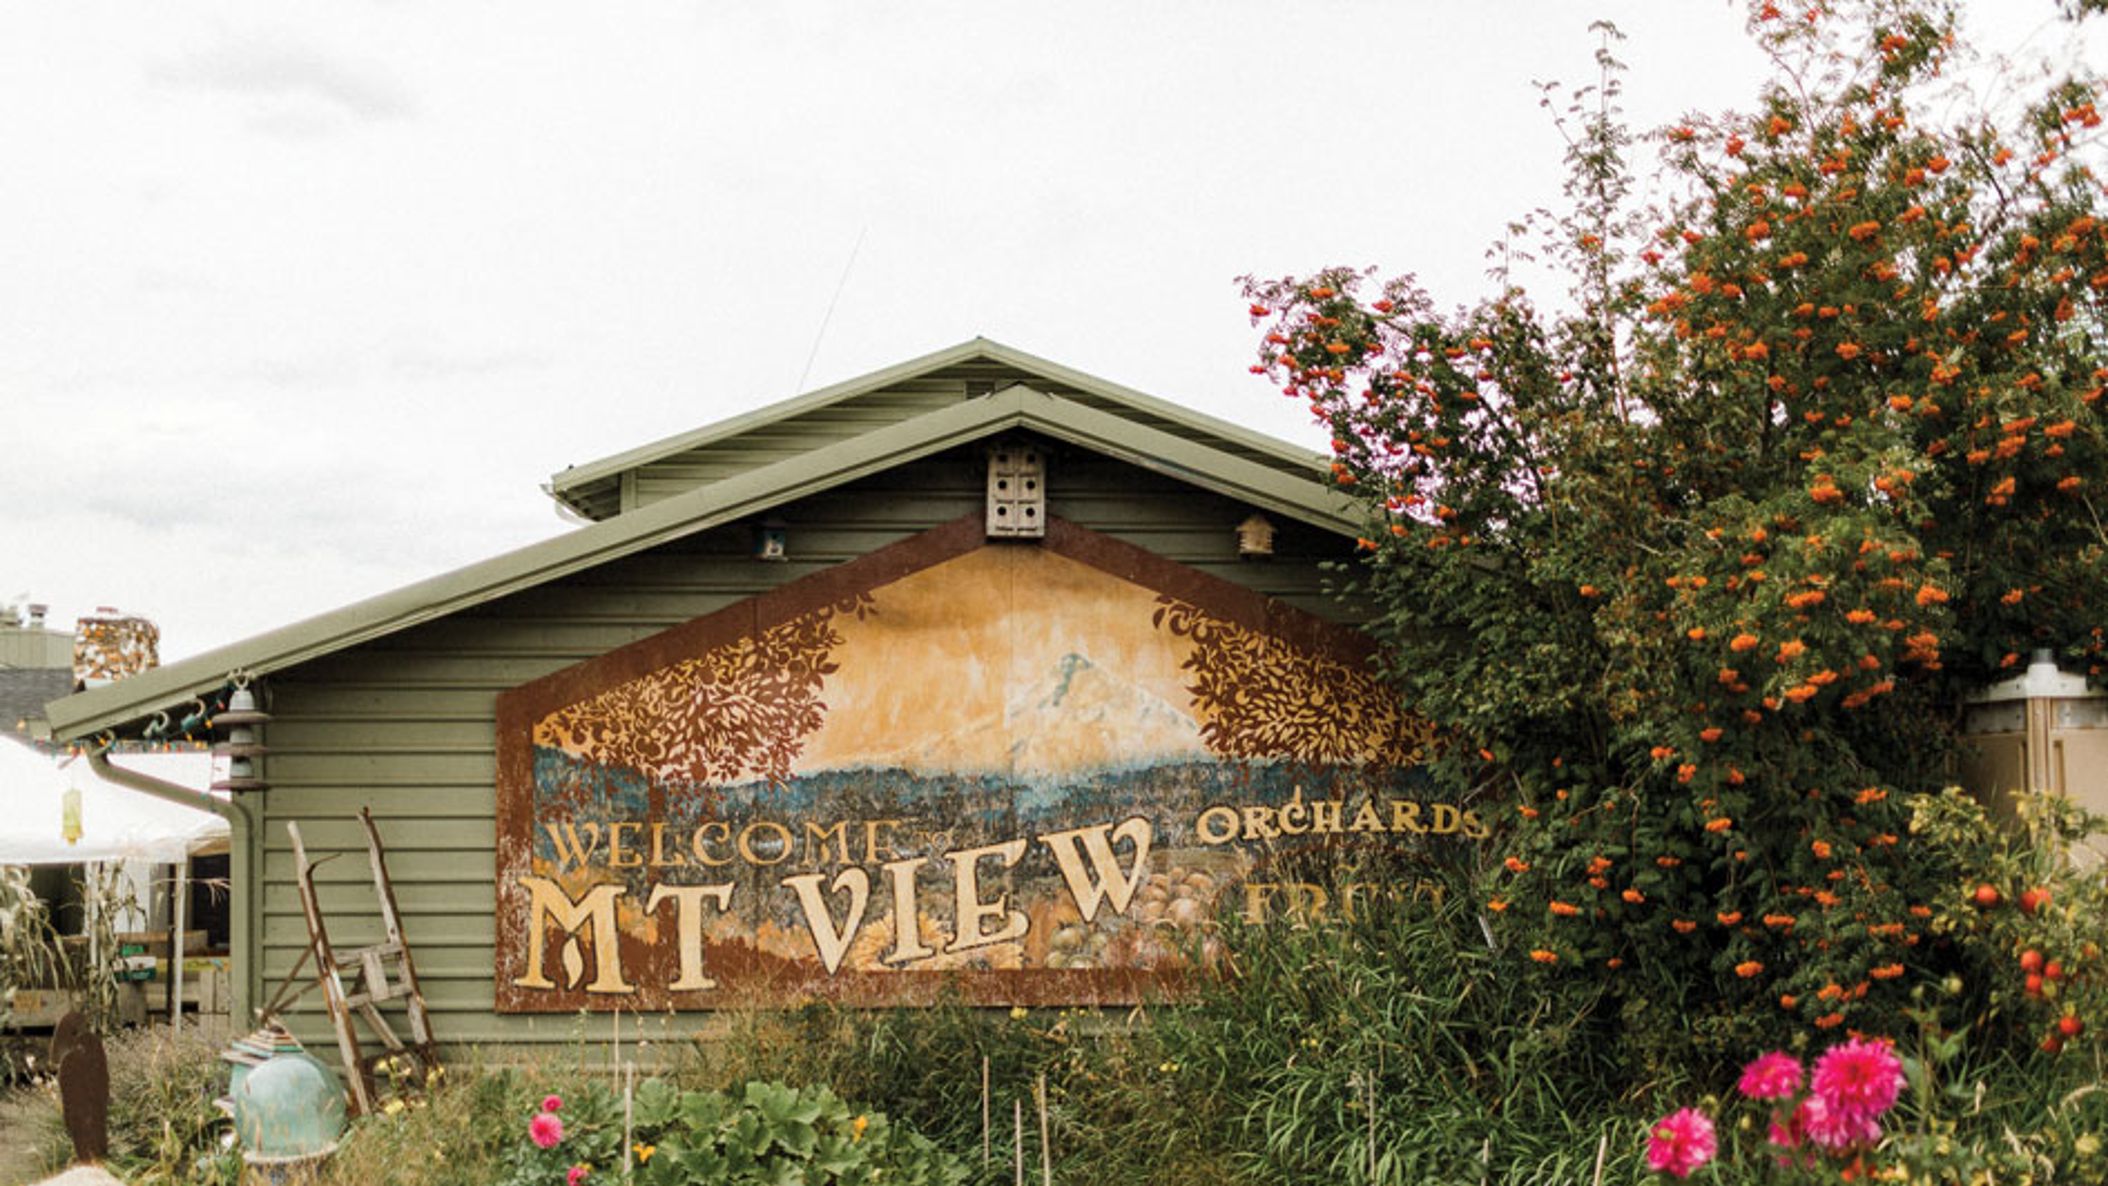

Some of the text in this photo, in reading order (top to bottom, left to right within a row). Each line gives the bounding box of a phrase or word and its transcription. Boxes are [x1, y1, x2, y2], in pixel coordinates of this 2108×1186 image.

[546, 820, 902, 866] WELCOME
[1197, 785, 1492, 844] ORCHARDS
[513, 815, 1151, 993] MT VIEW
